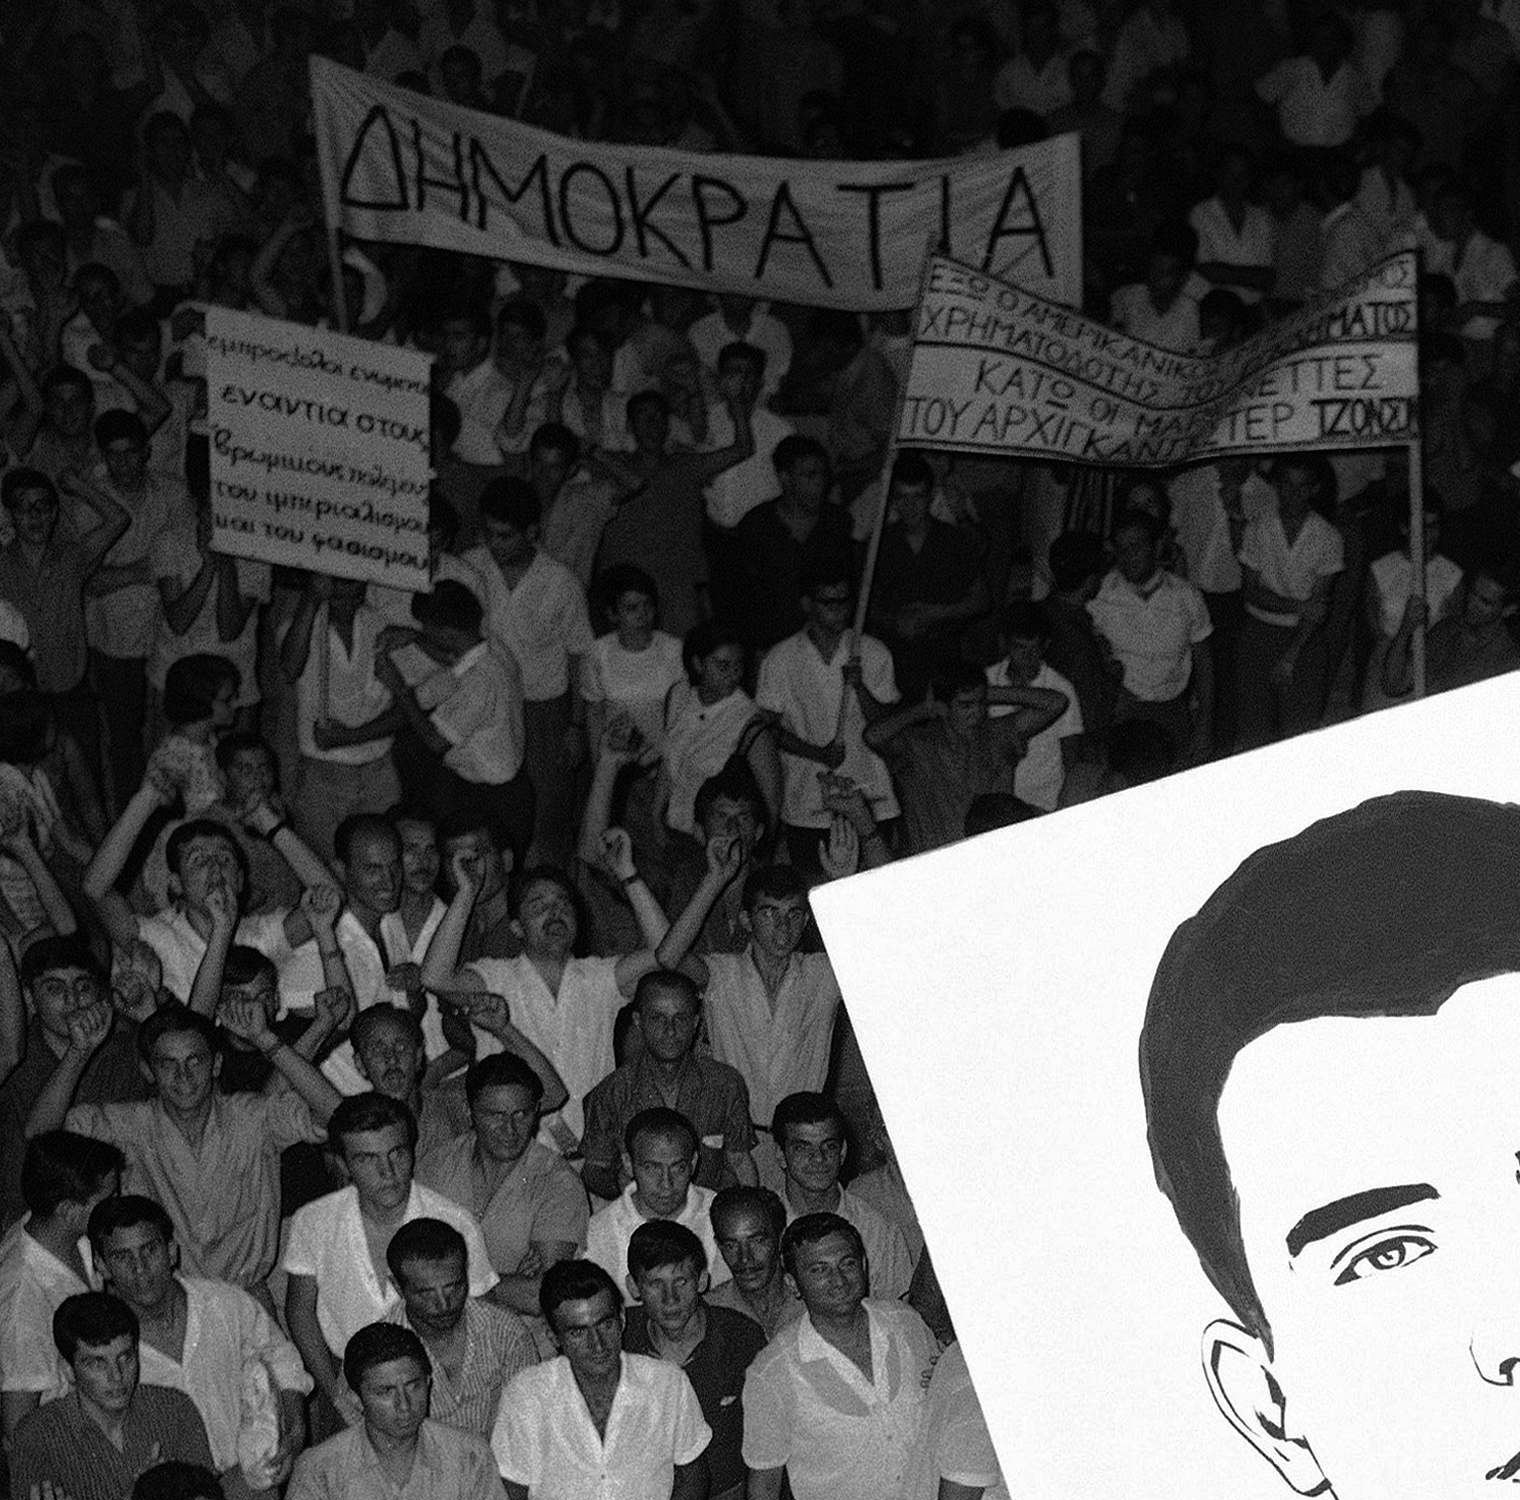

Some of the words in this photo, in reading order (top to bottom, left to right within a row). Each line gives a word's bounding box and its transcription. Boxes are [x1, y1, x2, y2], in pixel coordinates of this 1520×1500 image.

[340, 104, 1054, 290] ΔΗΜΟΚΡΑΤΙΑ
[920, 305, 1159, 401] ΧΡΗΜΑΤΟΔΟΤΗΣ
[221, 385, 349, 428] εναντια
[905, 396, 973, 436] ΤΟΥ
